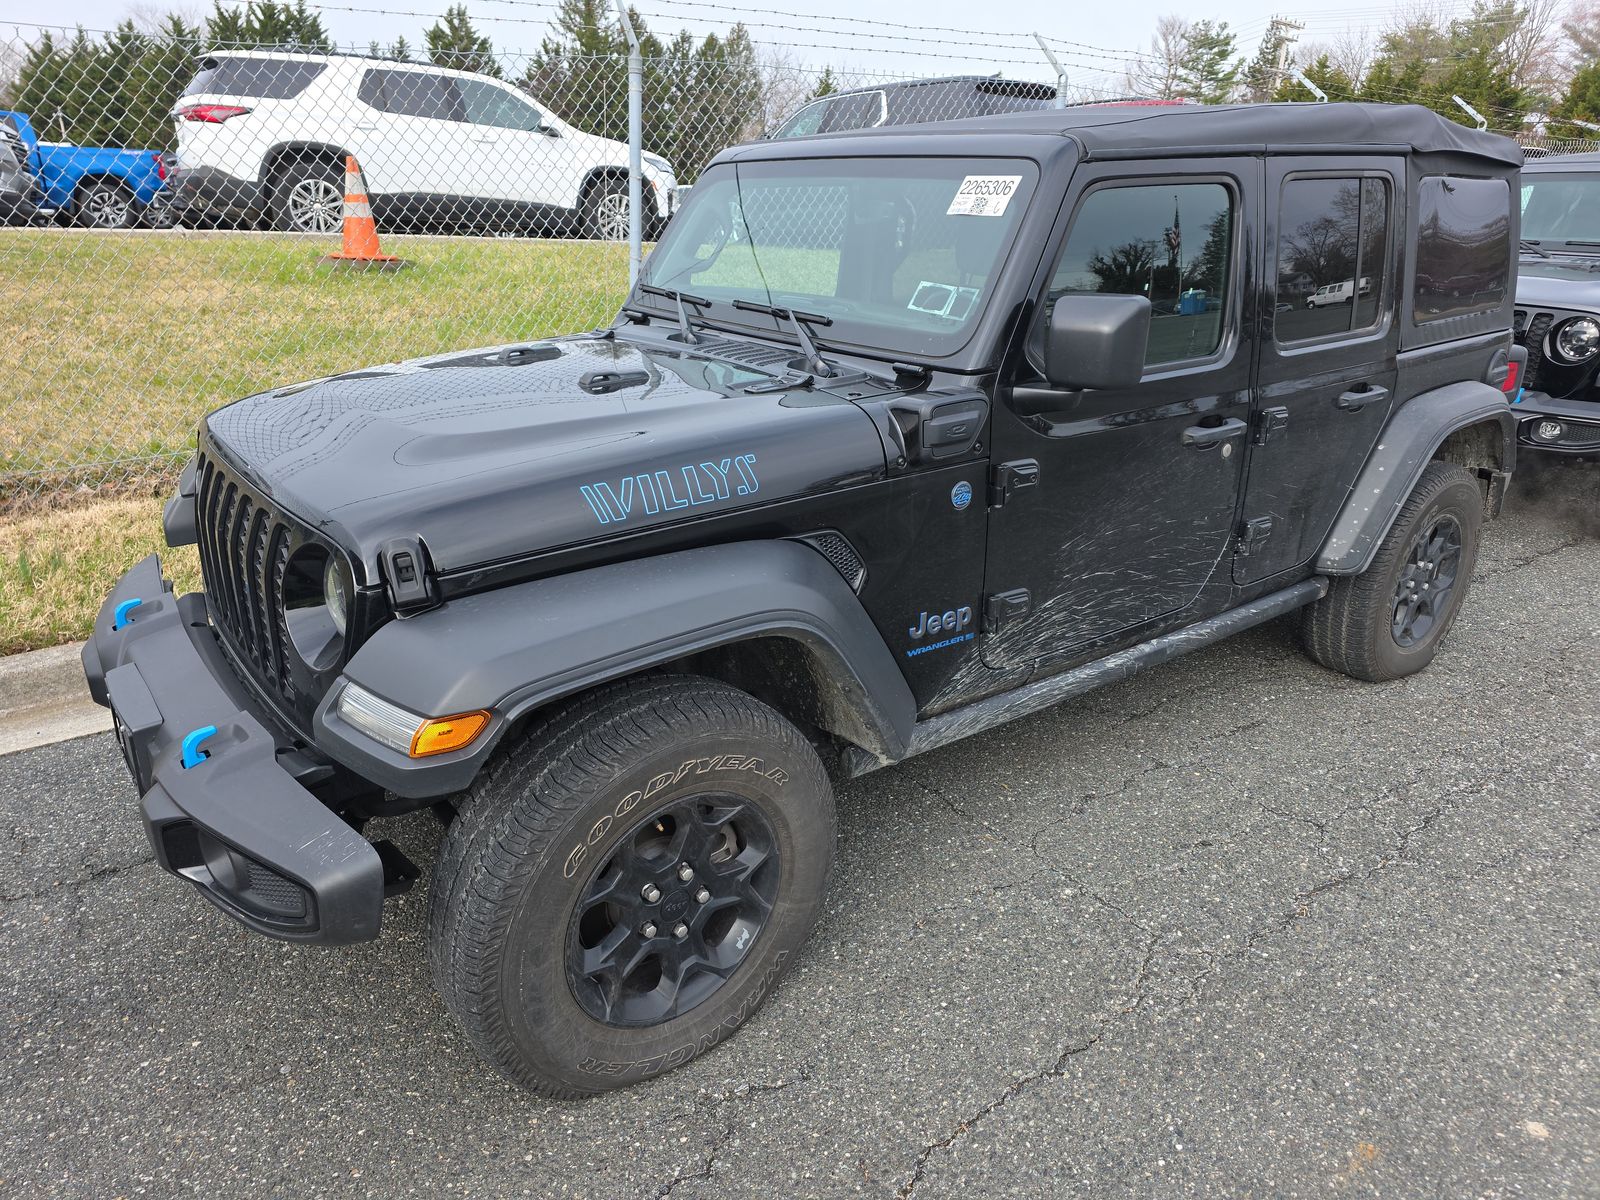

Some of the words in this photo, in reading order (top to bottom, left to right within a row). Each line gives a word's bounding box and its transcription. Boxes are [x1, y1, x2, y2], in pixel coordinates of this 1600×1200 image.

[960, 180, 1015, 196] 2265306
[579, 453, 759, 524] WILLYS
[906, 635, 964, 657] WRANGLER
[909, 606, 973, 640] Jeep
[563, 754, 790, 879] GOODYEAR
[576, 950, 790, 1077] WRANGLER
